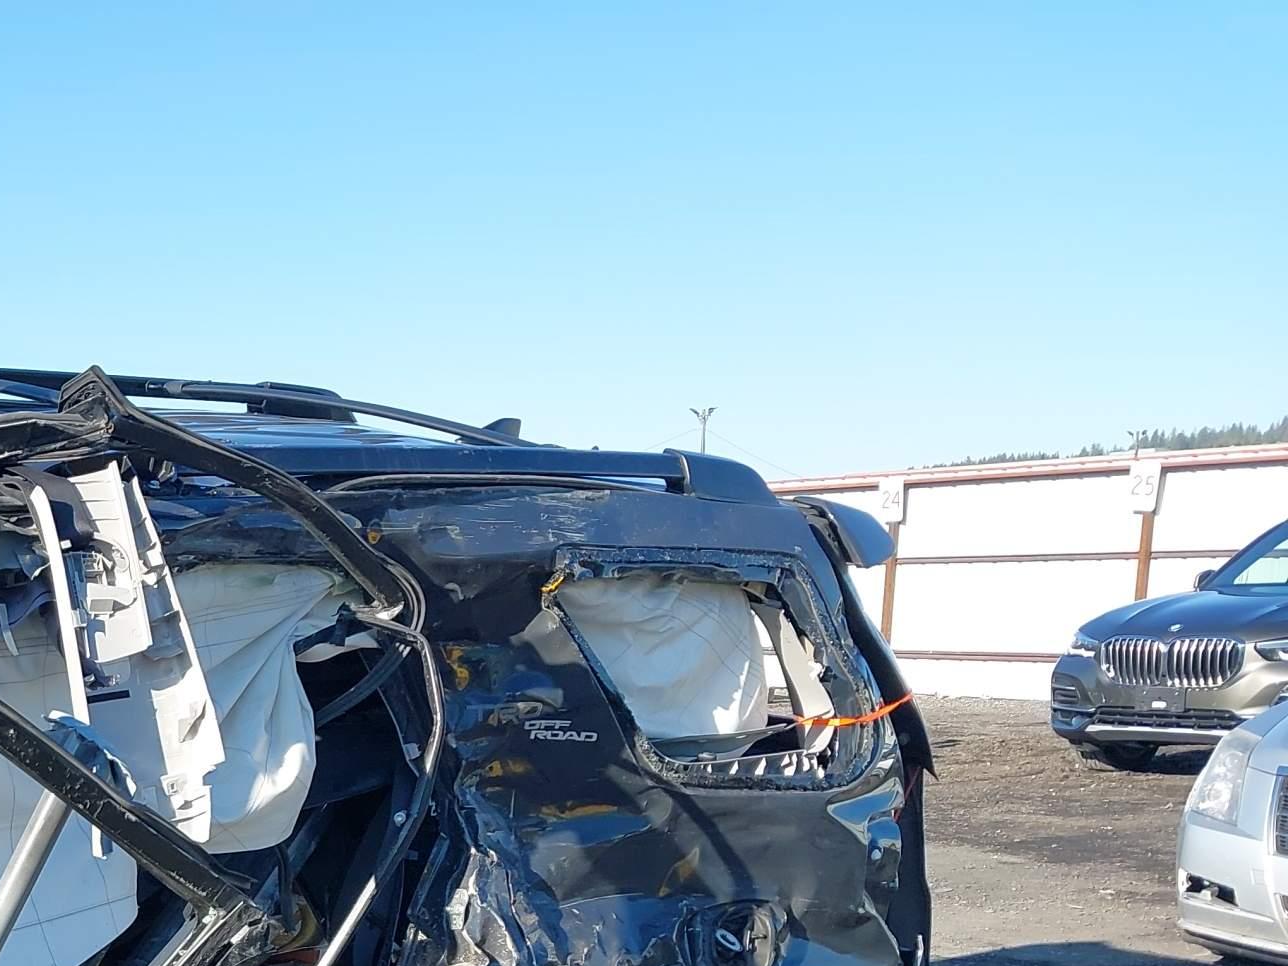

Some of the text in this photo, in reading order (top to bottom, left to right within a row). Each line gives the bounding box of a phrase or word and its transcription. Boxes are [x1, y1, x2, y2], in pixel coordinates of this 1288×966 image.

[1131, 474, 1155, 496] 25
[882, 490, 901, 510] 24
[466, 701, 543, 727] TRD
[523, 720, 572, 730] OFF
[529, 730, 598, 742] ROAD
